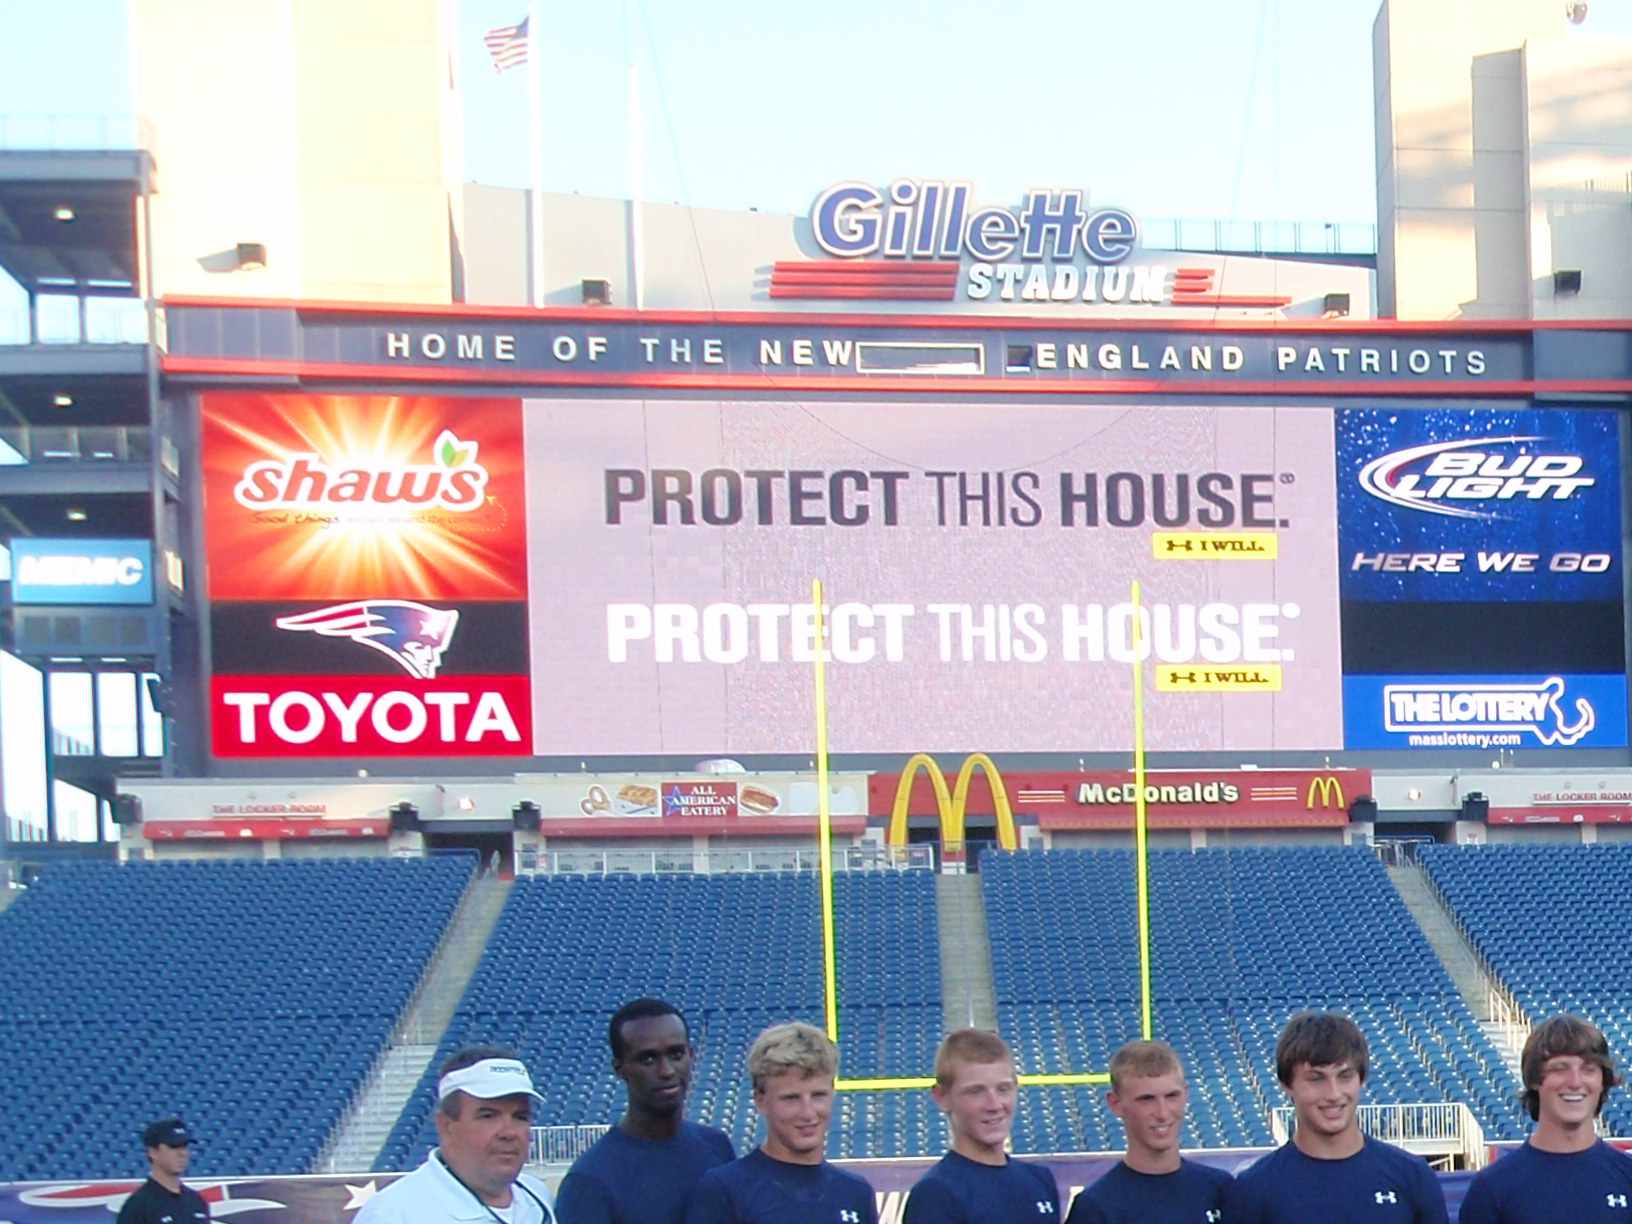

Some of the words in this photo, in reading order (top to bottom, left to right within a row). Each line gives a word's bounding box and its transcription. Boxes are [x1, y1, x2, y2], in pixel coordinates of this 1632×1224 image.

[812, 179, 1137, 263] Gillette
[968, 263, 1168, 303] STADIUM
[386, 333, 516, 360] HOME
[553, 335, 609, 361] OF
[641, 338, 725, 363] THE
[760, 339, 856, 366] NEW
[1036, 344, 1245, 371] ENGLAND
[1278, 346, 1487, 375] PATRIOTS
[1424, 452, 1583, 478] BUD
[604, 468, 910, 526] PROTECT
[925, 471, 1043, 528] THIS
[1391, 475, 1596, 500] LIGHT
[1200, 540, 1209, 552] I
[1351, 551, 1465, 573] HERE
[1477, 551, 1539, 573] WE
[1550, 554, 1612, 573] GO
[606, 602, 915, 664] PROTECT
[926, 602, 1049, 663] THIS
[1204, 671, 1212, 684] I
[223, 691, 522, 744] TOYOTA
[1390, 693, 1440, 722] THE
[1441, 692, 1551, 722] LOTTERY
[1408, 732, 1521, 748] masslottery.com
[672, 795, 737, 806] AMERICAN
[690, 785, 717, 796] ALL
[1078, 782, 1239, 804] McDonald's
[1533, 792, 1552, 801] THE
[1556, 792, 1597, 801] LOCKER
[1600, 792, 1632, 801] ROOM
[681, 806, 728, 816] EATERY
